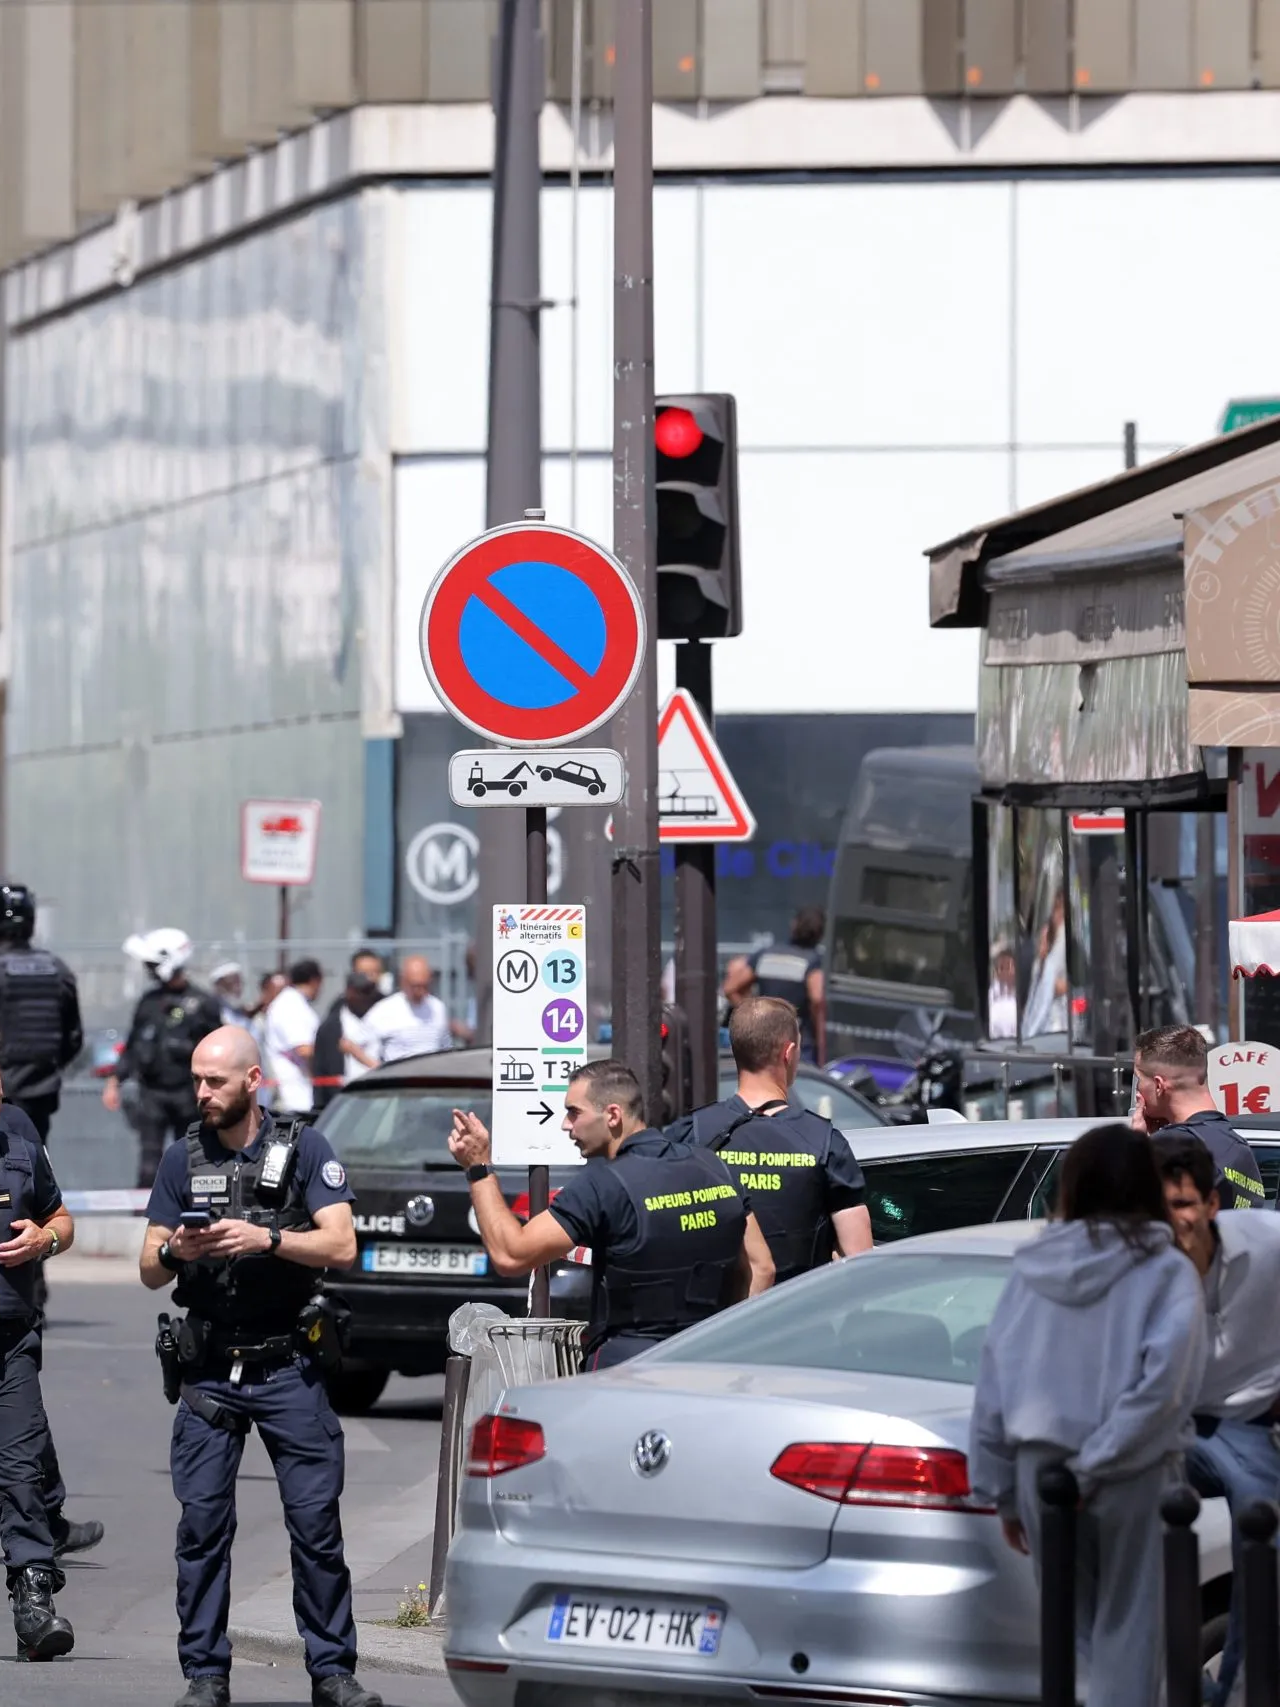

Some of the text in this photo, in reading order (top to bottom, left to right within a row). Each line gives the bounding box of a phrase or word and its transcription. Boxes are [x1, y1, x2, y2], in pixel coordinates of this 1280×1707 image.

[520, 923, 561, 931] Itinéraires
[520, 932, 562, 940] alternatifs
[571, 926, 578, 936] C
[507, 960, 528, 983] M
[547, 959, 577, 984] 13
[546, 1008, 578, 1033] 14
[1219, 1051, 1268, 1067] CAFÉ
[1219, 1082, 1271, 1116] 1€
[717, 1150, 816, 1167] PEURS POMPIERS
[740, 1173, 781, 1190] PARIS
[645, 1193, 691, 1211] SAPEURS
[680, 1210, 717, 1232] PARIS
[565, 1603, 702, 1646] EV-021-HK
